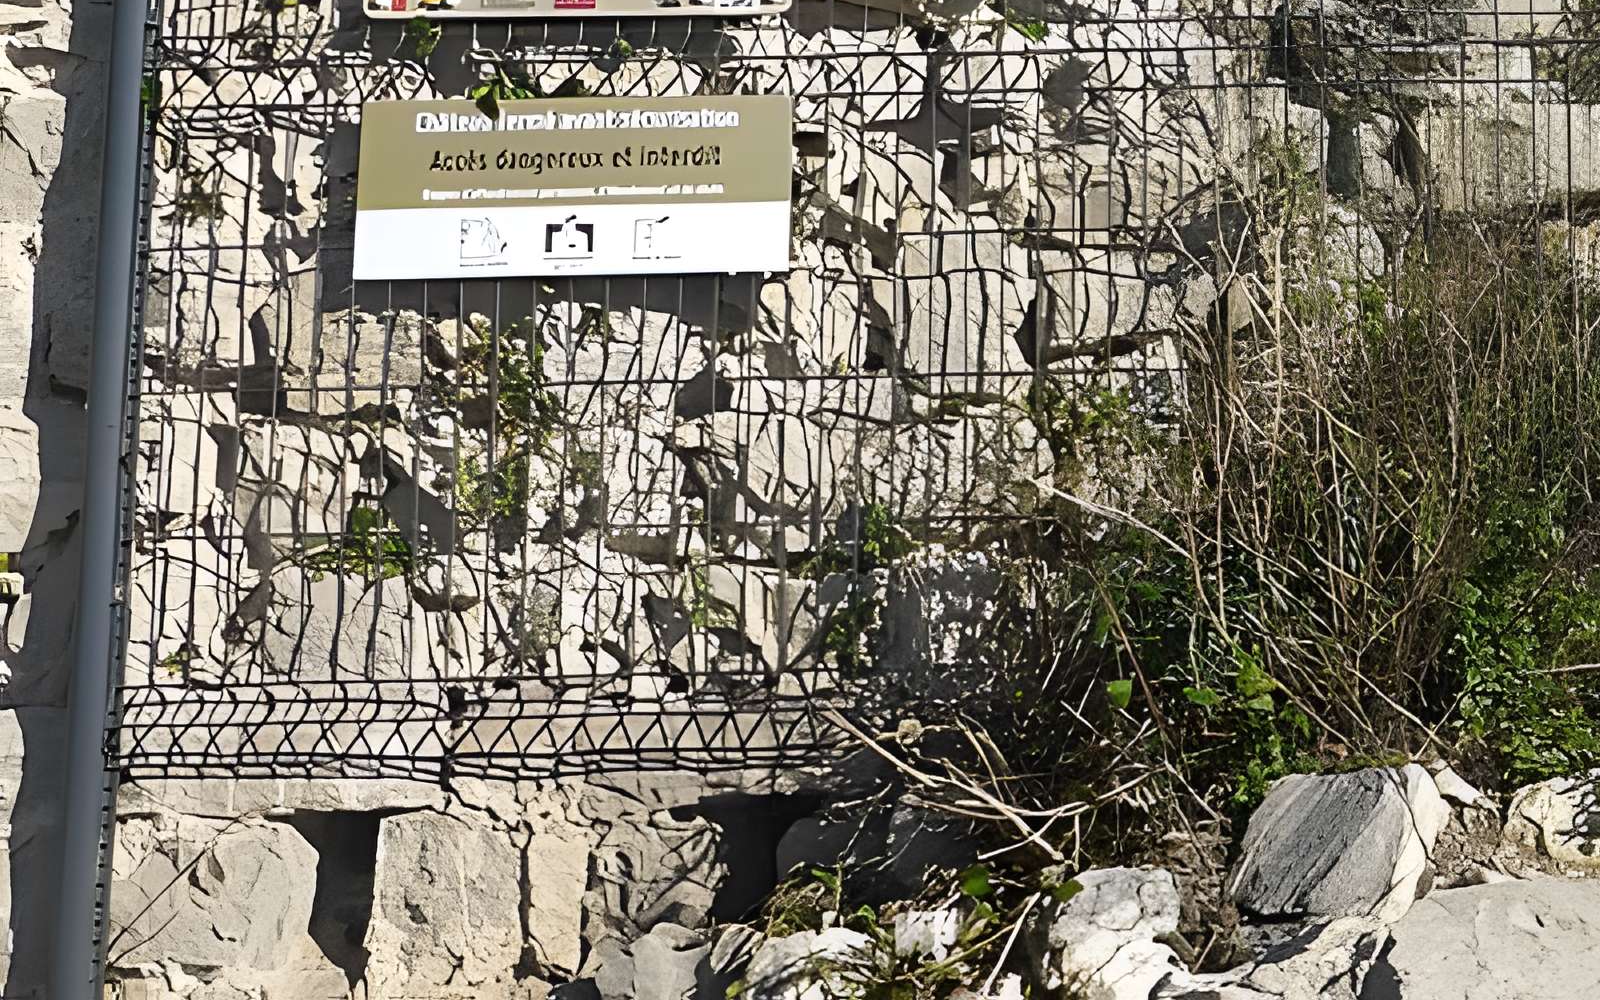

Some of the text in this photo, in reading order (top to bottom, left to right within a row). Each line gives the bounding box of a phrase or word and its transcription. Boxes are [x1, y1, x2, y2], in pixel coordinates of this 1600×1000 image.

[496, 148, 603, 174] dangereux
[612, 146, 632, 168] et
[640, 145, 721, 167] interdit
